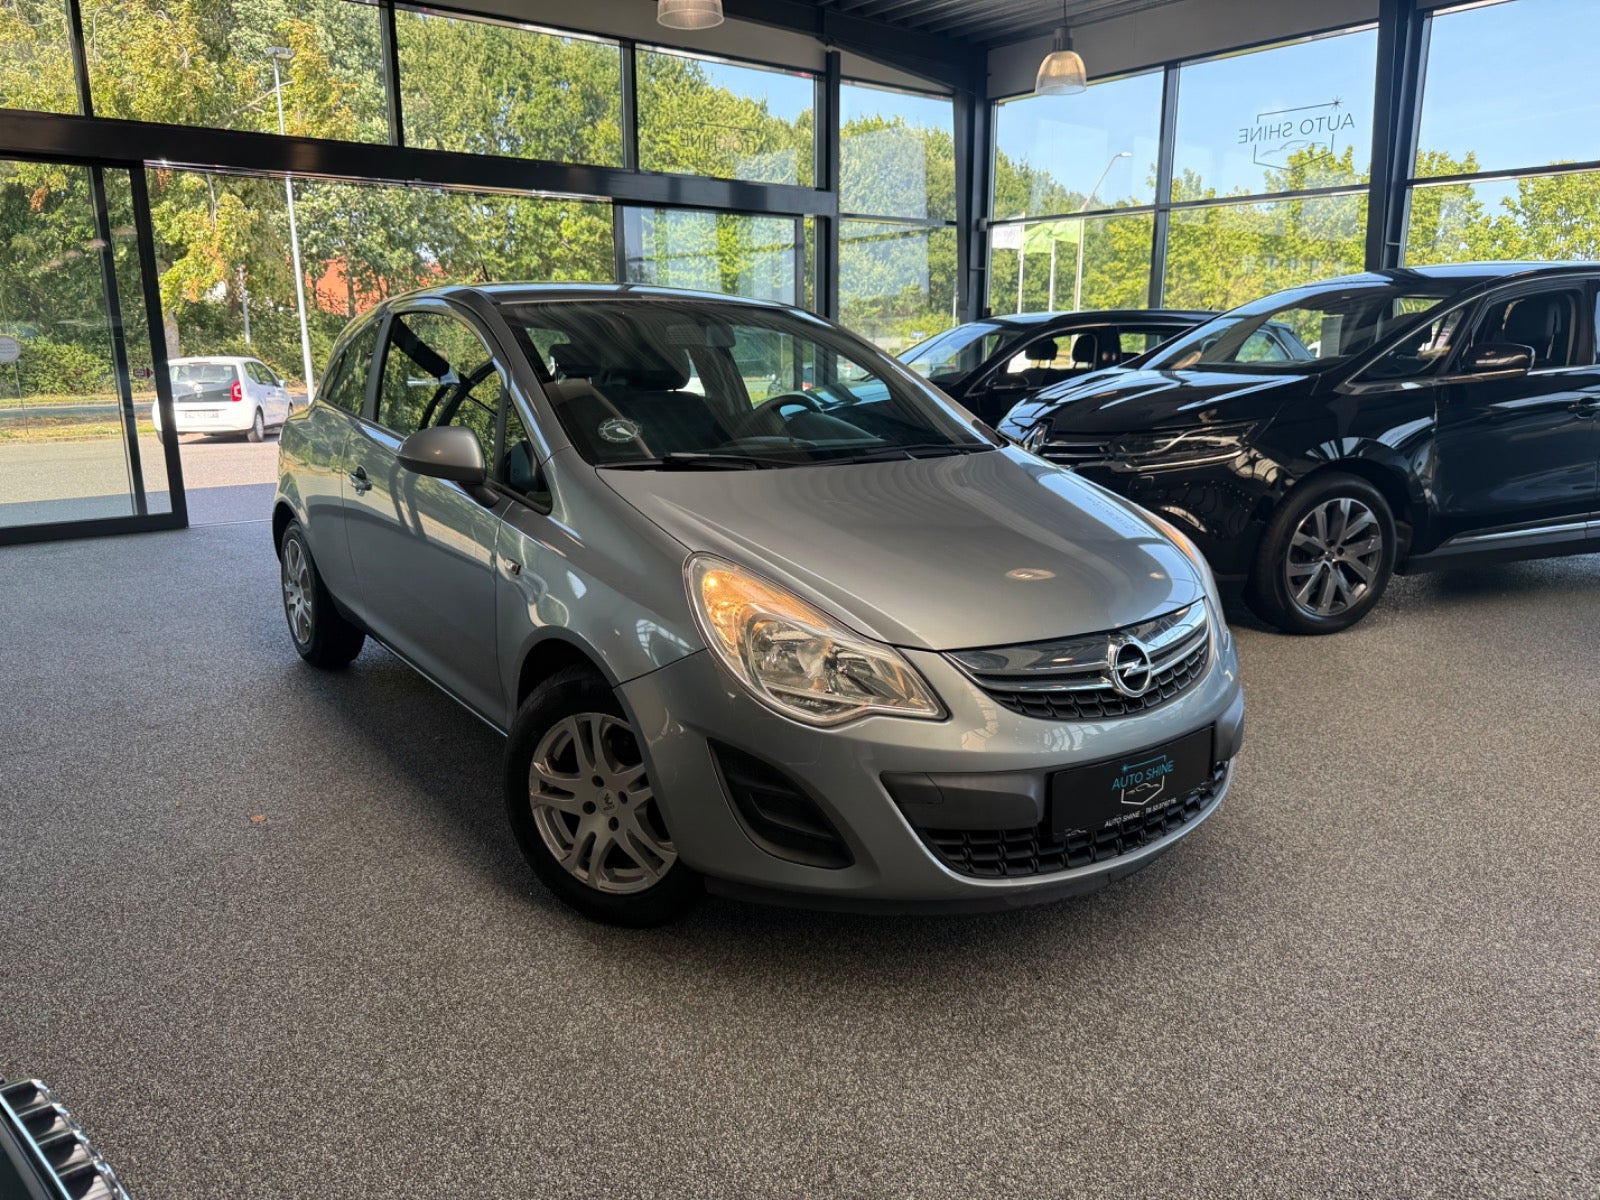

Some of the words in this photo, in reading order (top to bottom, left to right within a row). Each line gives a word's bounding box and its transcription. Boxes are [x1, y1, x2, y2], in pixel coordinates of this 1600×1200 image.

[1112, 772, 1143, 790] AUTO
[1146, 760, 1174, 780] SHINE
[1104, 816, 1122, 828] AUTO
[1122, 810, 1140, 822] SHINE
